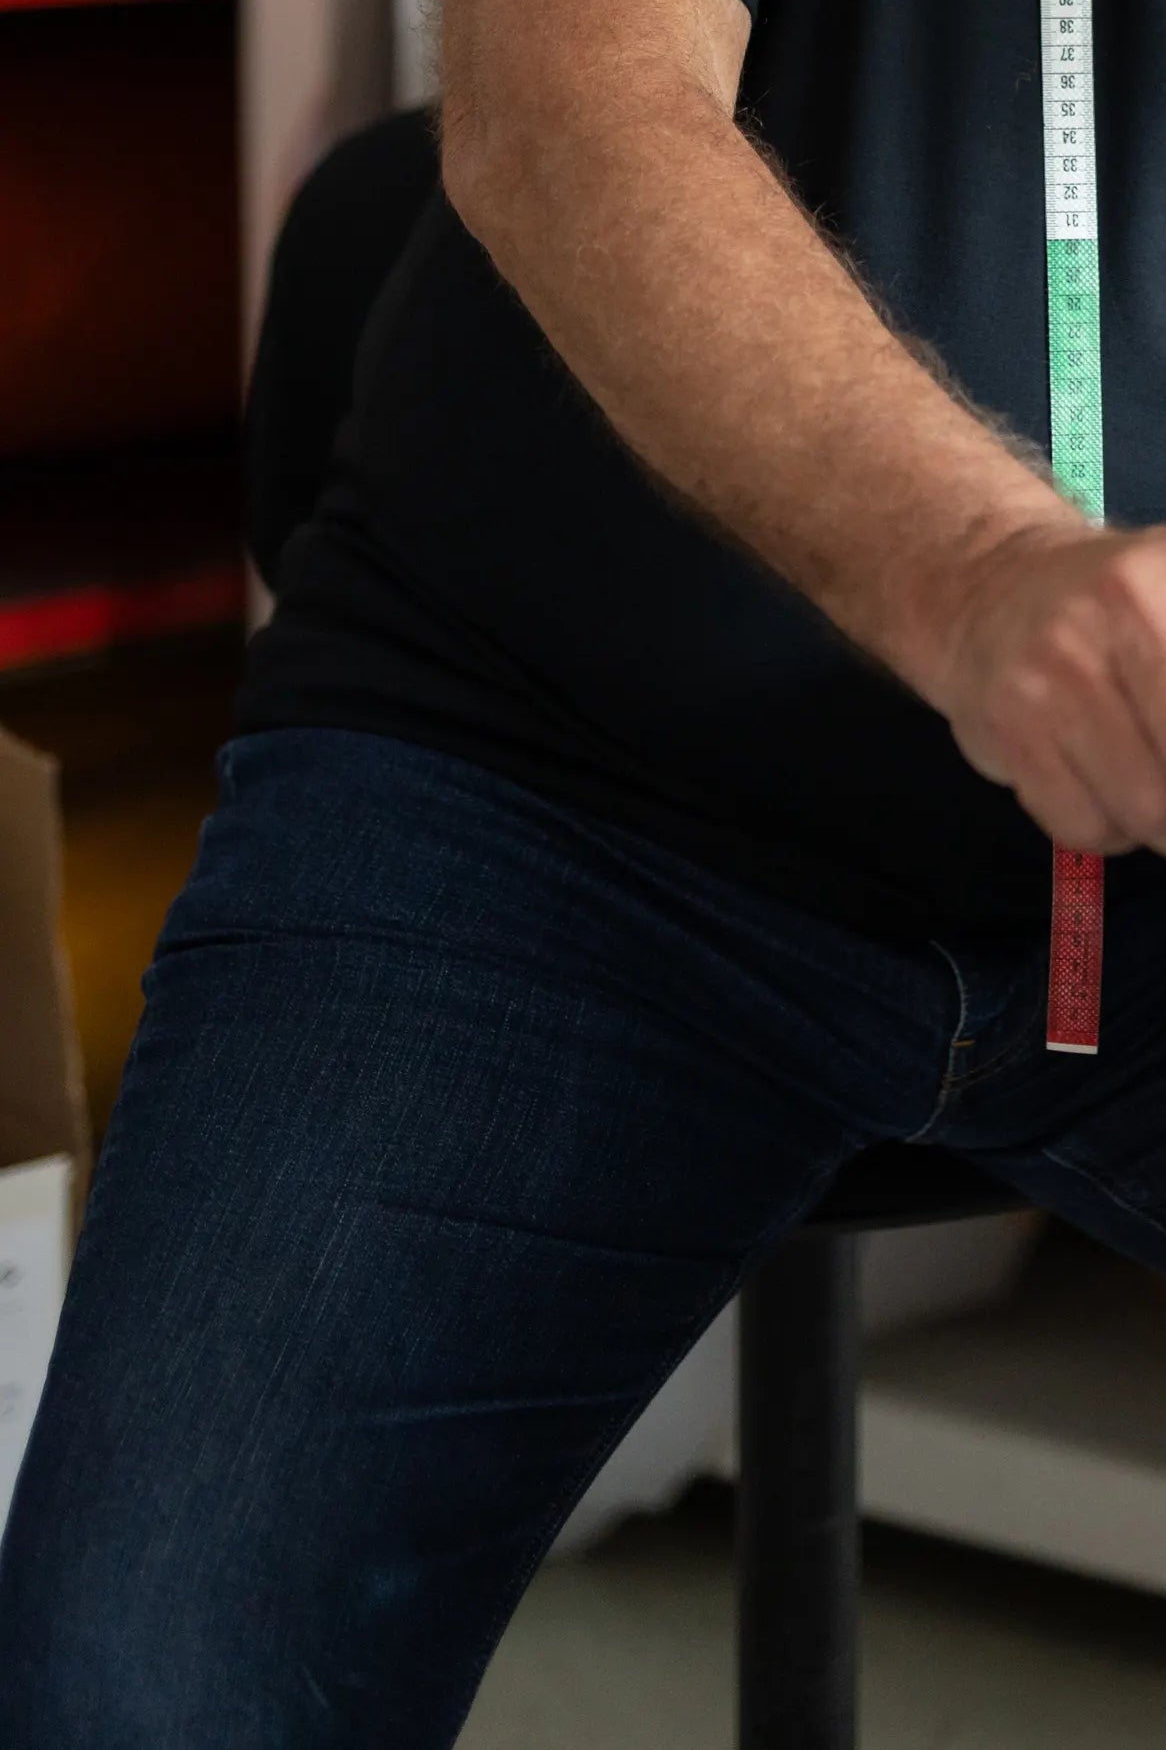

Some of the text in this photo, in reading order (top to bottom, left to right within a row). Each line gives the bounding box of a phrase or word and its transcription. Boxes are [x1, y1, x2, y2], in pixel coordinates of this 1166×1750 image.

[1060, 20, 1074, 33] 38
[1060, 48, 1075, 61] 37
[1060, 75, 1076, 89] 36
[1061, 103, 1076, 117] 35
[1062, 131, 1076, 144] 34
[1063, 158, 1078, 172] 33
[1064, 186, 1078, 200] 32
[1066, 214, 1079, 227] 31
